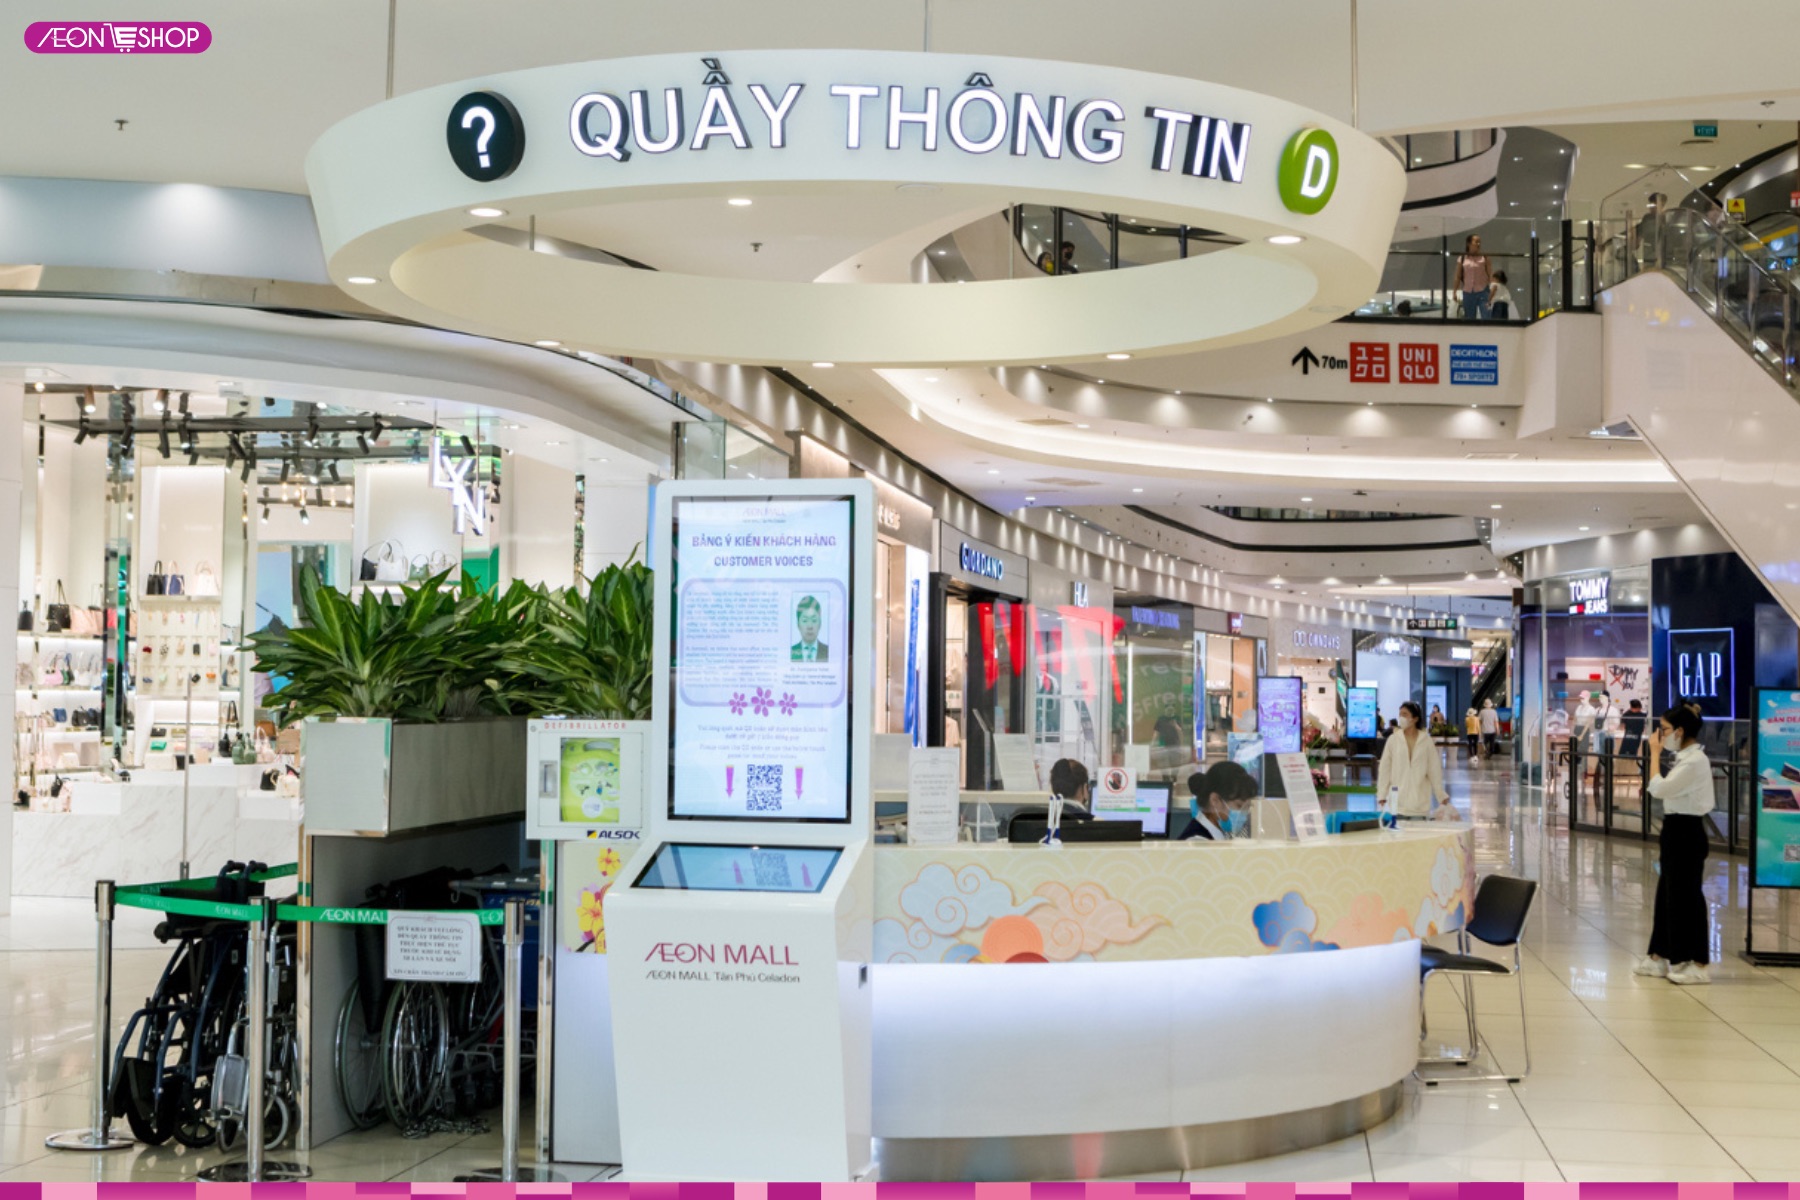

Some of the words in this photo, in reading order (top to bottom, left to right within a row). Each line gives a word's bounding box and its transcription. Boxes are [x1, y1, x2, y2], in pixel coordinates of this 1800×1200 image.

[569, 58, 806, 162] QUẦY
[829, 72, 1125, 164] THÔNG
[1144, 105, 1252, 183] TIN
[1300, 145, 1330, 198] D
[1403, 347, 1432, 362] UNI
[1450, 349, 1497, 358] DECATHLON
[1321, 356, 1348, 369] 70m
[1403, 365, 1435, 380] QLO
[430, 436, 485, 536] LYN
[692, 533, 723, 547] BẢNG
[763, 533, 801, 547] KHÁCH
[804, 533, 837, 547] HÀNG
[714, 556, 772, 567] CUSTOMER
[775, 556, 814, 567] VOICES
[960, 541, 1003, 580] GIORDANO
[1569, 576, 1609, 602] TOMMY
[1584, 599, 1608, 615] JEANS
[1679, 652, 1722, 697] GAP
[598, 830, 640, 839] ALSOK
[724, 944, 799, 966] MALL
[679, 971, 711, 981] MALL
[714, 971, 733, 981] Tân
[735, 971, 756, 982] Phú
[758, 972, 800, 983] Celadon
